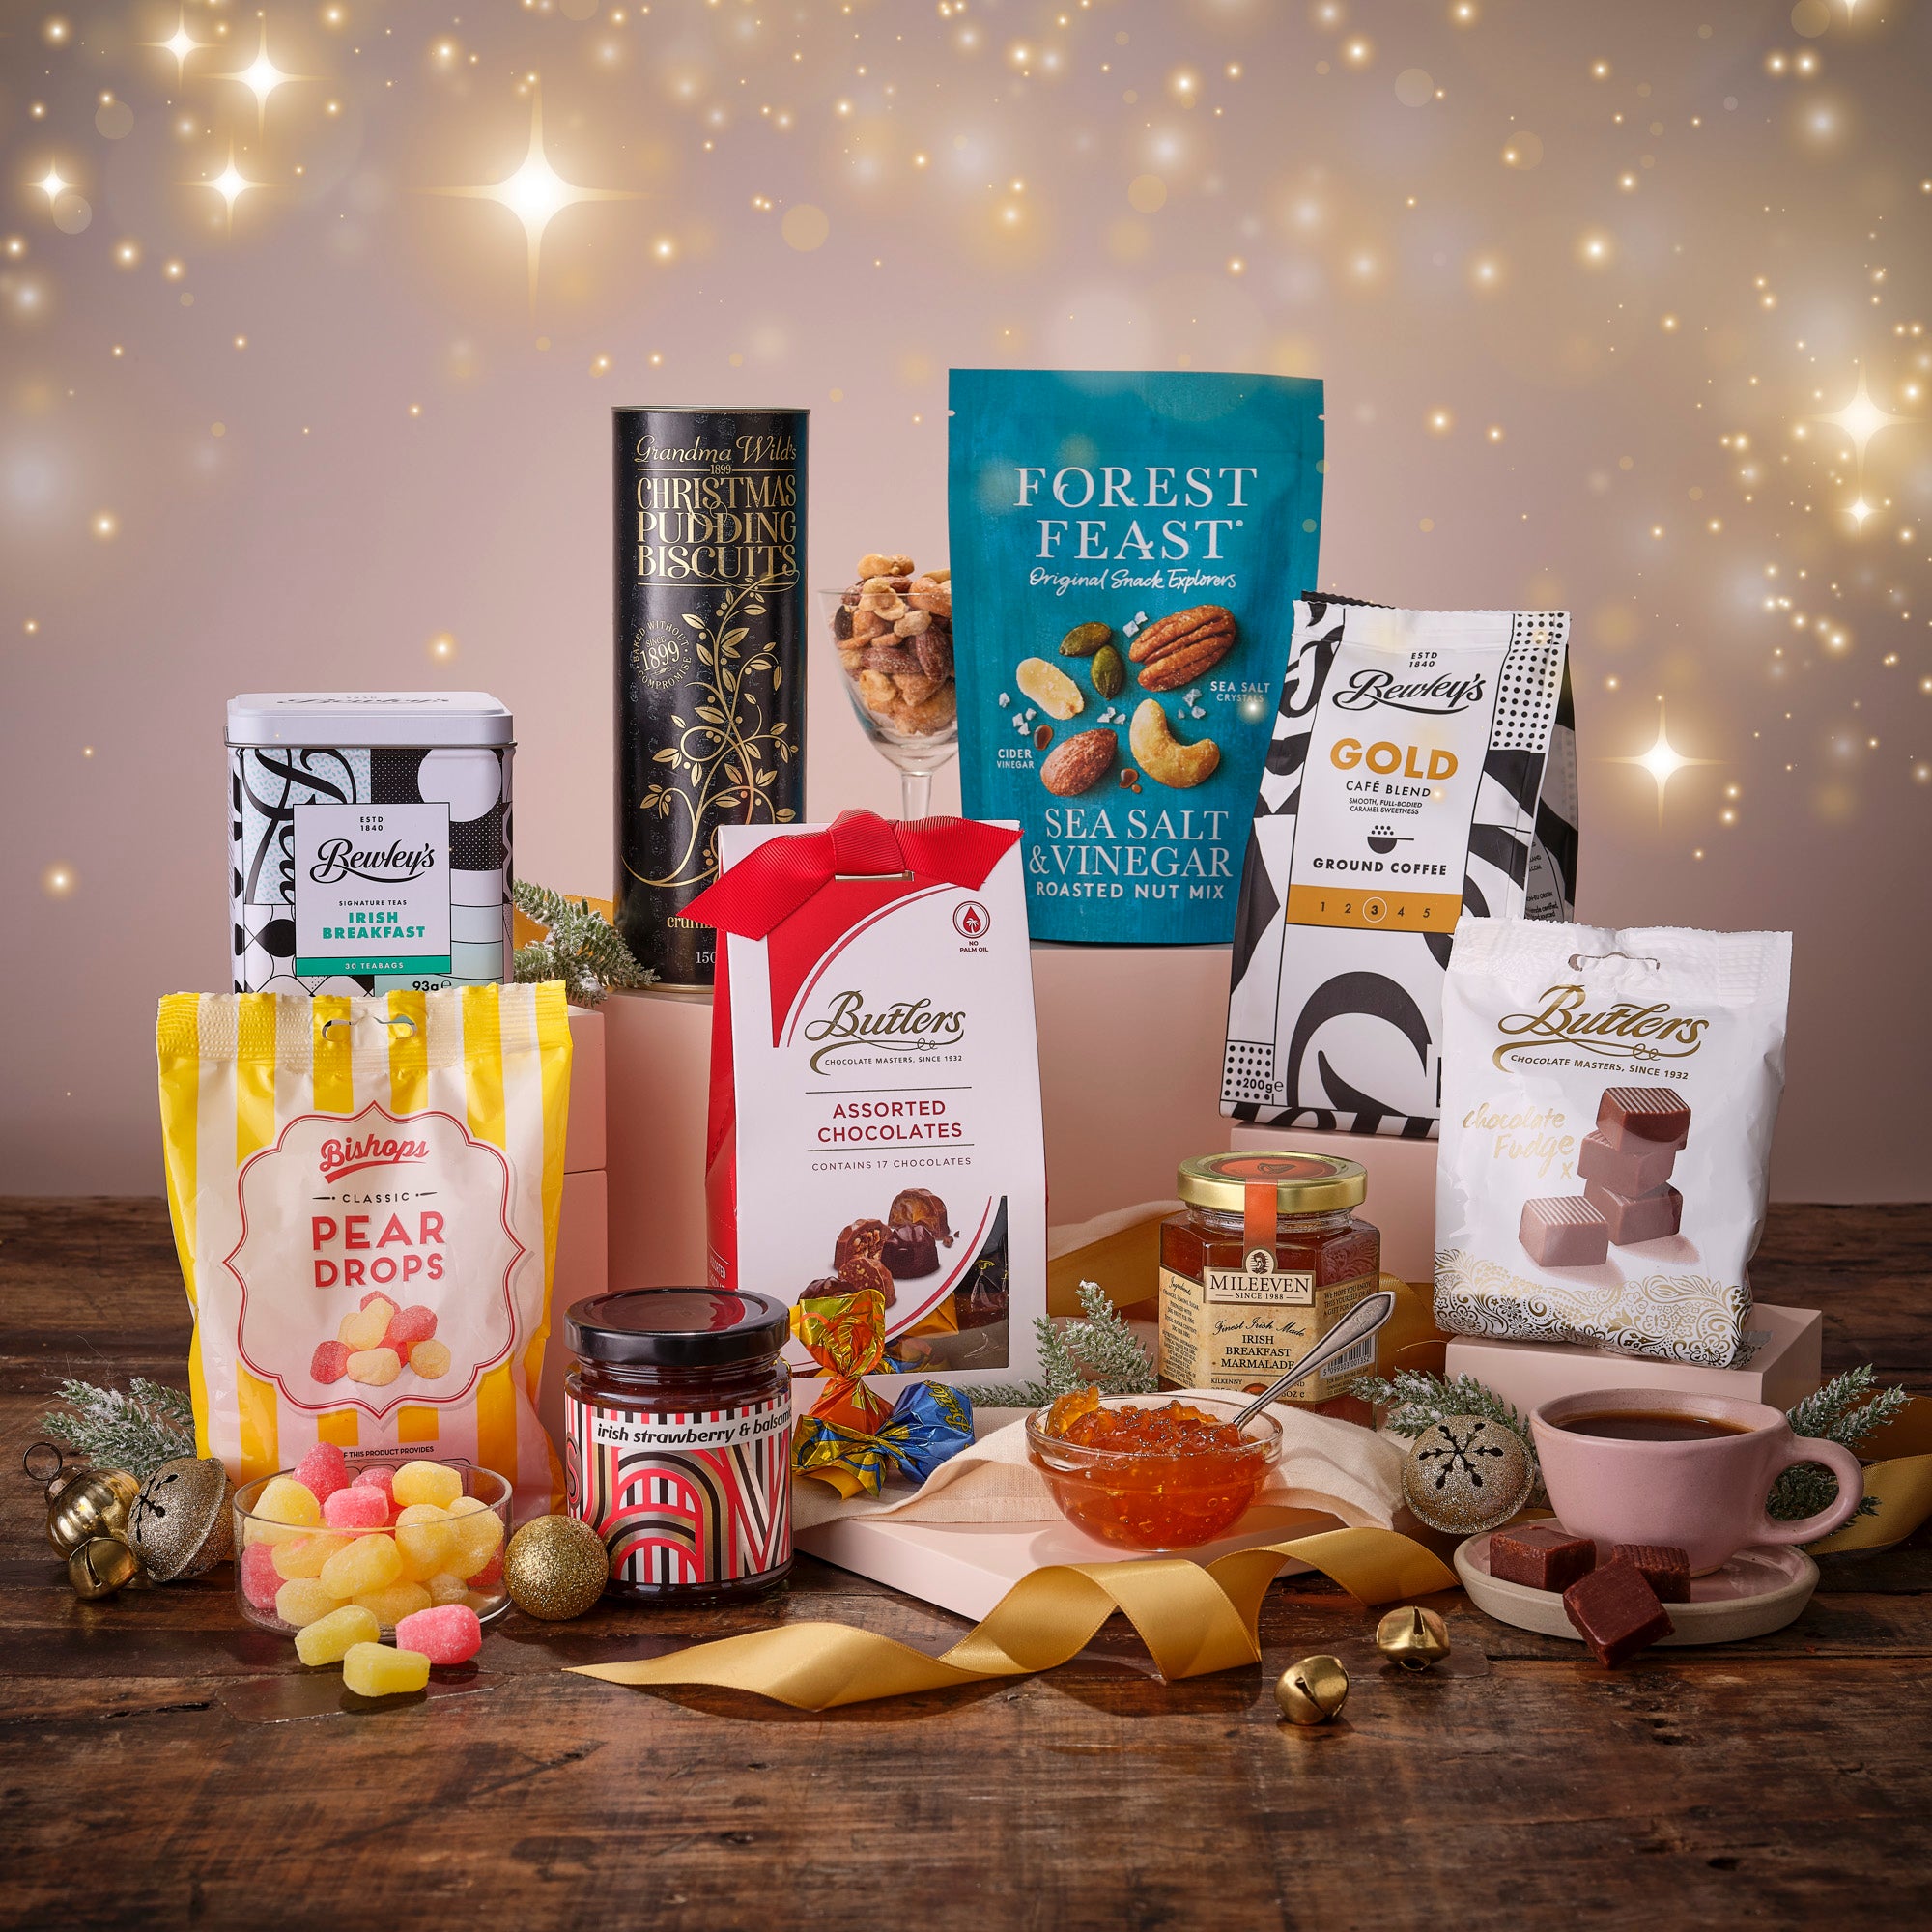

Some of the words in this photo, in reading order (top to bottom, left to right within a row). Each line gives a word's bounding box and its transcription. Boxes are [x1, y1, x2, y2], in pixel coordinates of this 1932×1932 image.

[634, 435, 731, 463] Grandma
[736, 436, 797, 464] Wild's
[710, 465, 731, 475] 1899
[637, 474, 797, 510] CHRISTMAS
[1013, 467, 1257, 508] FOREST
[637, 511, 797, 544] PUDDING
[637, 544, 798, 580] BISCUITS
[1029, 566, 1109, 597] Original
[1111, 568, 1165, 589] Snack
[1167, 568, 1236, 593] Explorers
[633, 627, 646, 663] BAKED
[646, 620, 690, 646] WITHOUT
[645, 636, 667, 648] SINCE
[639, 640, 680, 671] 1899
[1409, 660, 1435, 668] 1840
[1410, 651, 1438, 660] ESTD
[638, 656, 692, 689] COMPROMISE
[1210, 681, 1236, 692] SEA
[1241, 682, 1270, 693] SALT
[1332, 668, 1487, 715] Bewley's
[1216, 693, 1264, 703] CRYSTALS
[998, 748, 1032, 760] CIDER
[1330, 737, 1459, 781] GOLD
[996, 759, 1035, 769] VINEGAR
[1346, 780, 1380, 793] CAFÉ
[1385, 784, 1431, 797] BLEND
[1349, 797, 1378, 806] SMOOTH,
[1379, 799, 1423, 808] FULL-BODIED
[1350, 805, 1379, 813] CARAMEL
[1380, 807, 1420, 815] SWEETNESS
[1045, 808, 1117, 839] SEA
[1127, 809, 1229, 840] SALT
[309, 838, 435, 884] Bewley's
[1312, 857, 1384, 873] GROUND
[1390, 862, 1447, 876] COFFEE
[1037, 881, 1124, 899] ROASTED
[1134, 883, 1184, 899] NUT
[1189, 884, 1224, 900] MIX
[348, 911, 398, 924] IRISH
[1320, 902, 1326, 912] 1
[1344, 903, 1351, 914] 2
[1370, 905, 1378, 915] 3
[1397, 906, 1405, 917] 4
[1422, 908, 1430, 918] 5
[322, 926, 426, 939] BREAKFAST
[360, 962, 405, 970] TEABAGS
[804, 989, 967, 1051] Butlers
[1495, 983, 1710, 1055] Butlers
[875, 1056, 916, 1065] MASTERS,
[1510, 1054, 1571, 1066] CHOCOLATE
[1574, 1059, 1625, 1073] MASTERS,
[1628, 1064, 1660, 1077] SINCE
[1663, 1069, 1689, 1080] 1932
[832, 1100, 946, 1119] ASSORTED
[1462, 1101, 1566, 1130] chocolate
[817, 1122, 963, 1142] CHOCOLATES
[319, 1133, 431, 1174] Bishops
[1493, 1133, 1576, 1179] Fudge
[811, 1161, 872, 1171] CONTAINS
[877, 1160, 888, 1169] 17
[893, 1157, 972, 1168] CHOCOLATES
[342, 1191, 410, 1204] CLASSIC
[311, 1210, 447, 1252] PEAR
[313, 1253, 446, 1288] DROPS
[1210, 1274, 1312, 1293] MILEEVEN
[1213, 1319, 1245, 1335] Finest
[1246, 1316, 1275, 1330] Irish
[1276, 1322, 1307, 1337] Made
[1242, 1335, 1275, 1344] IRISH
[1225, 1346, 1291, 1357] BREAKFAST
[597, 1423, 629, 1442] irish
[633, 1427, 736, 1444] strawberry
[739, 1422, 750, 1436] &
[365, 1449, 399, 1457] PRODUCT
[400, 1446, 435, 1454] PROVIDES
